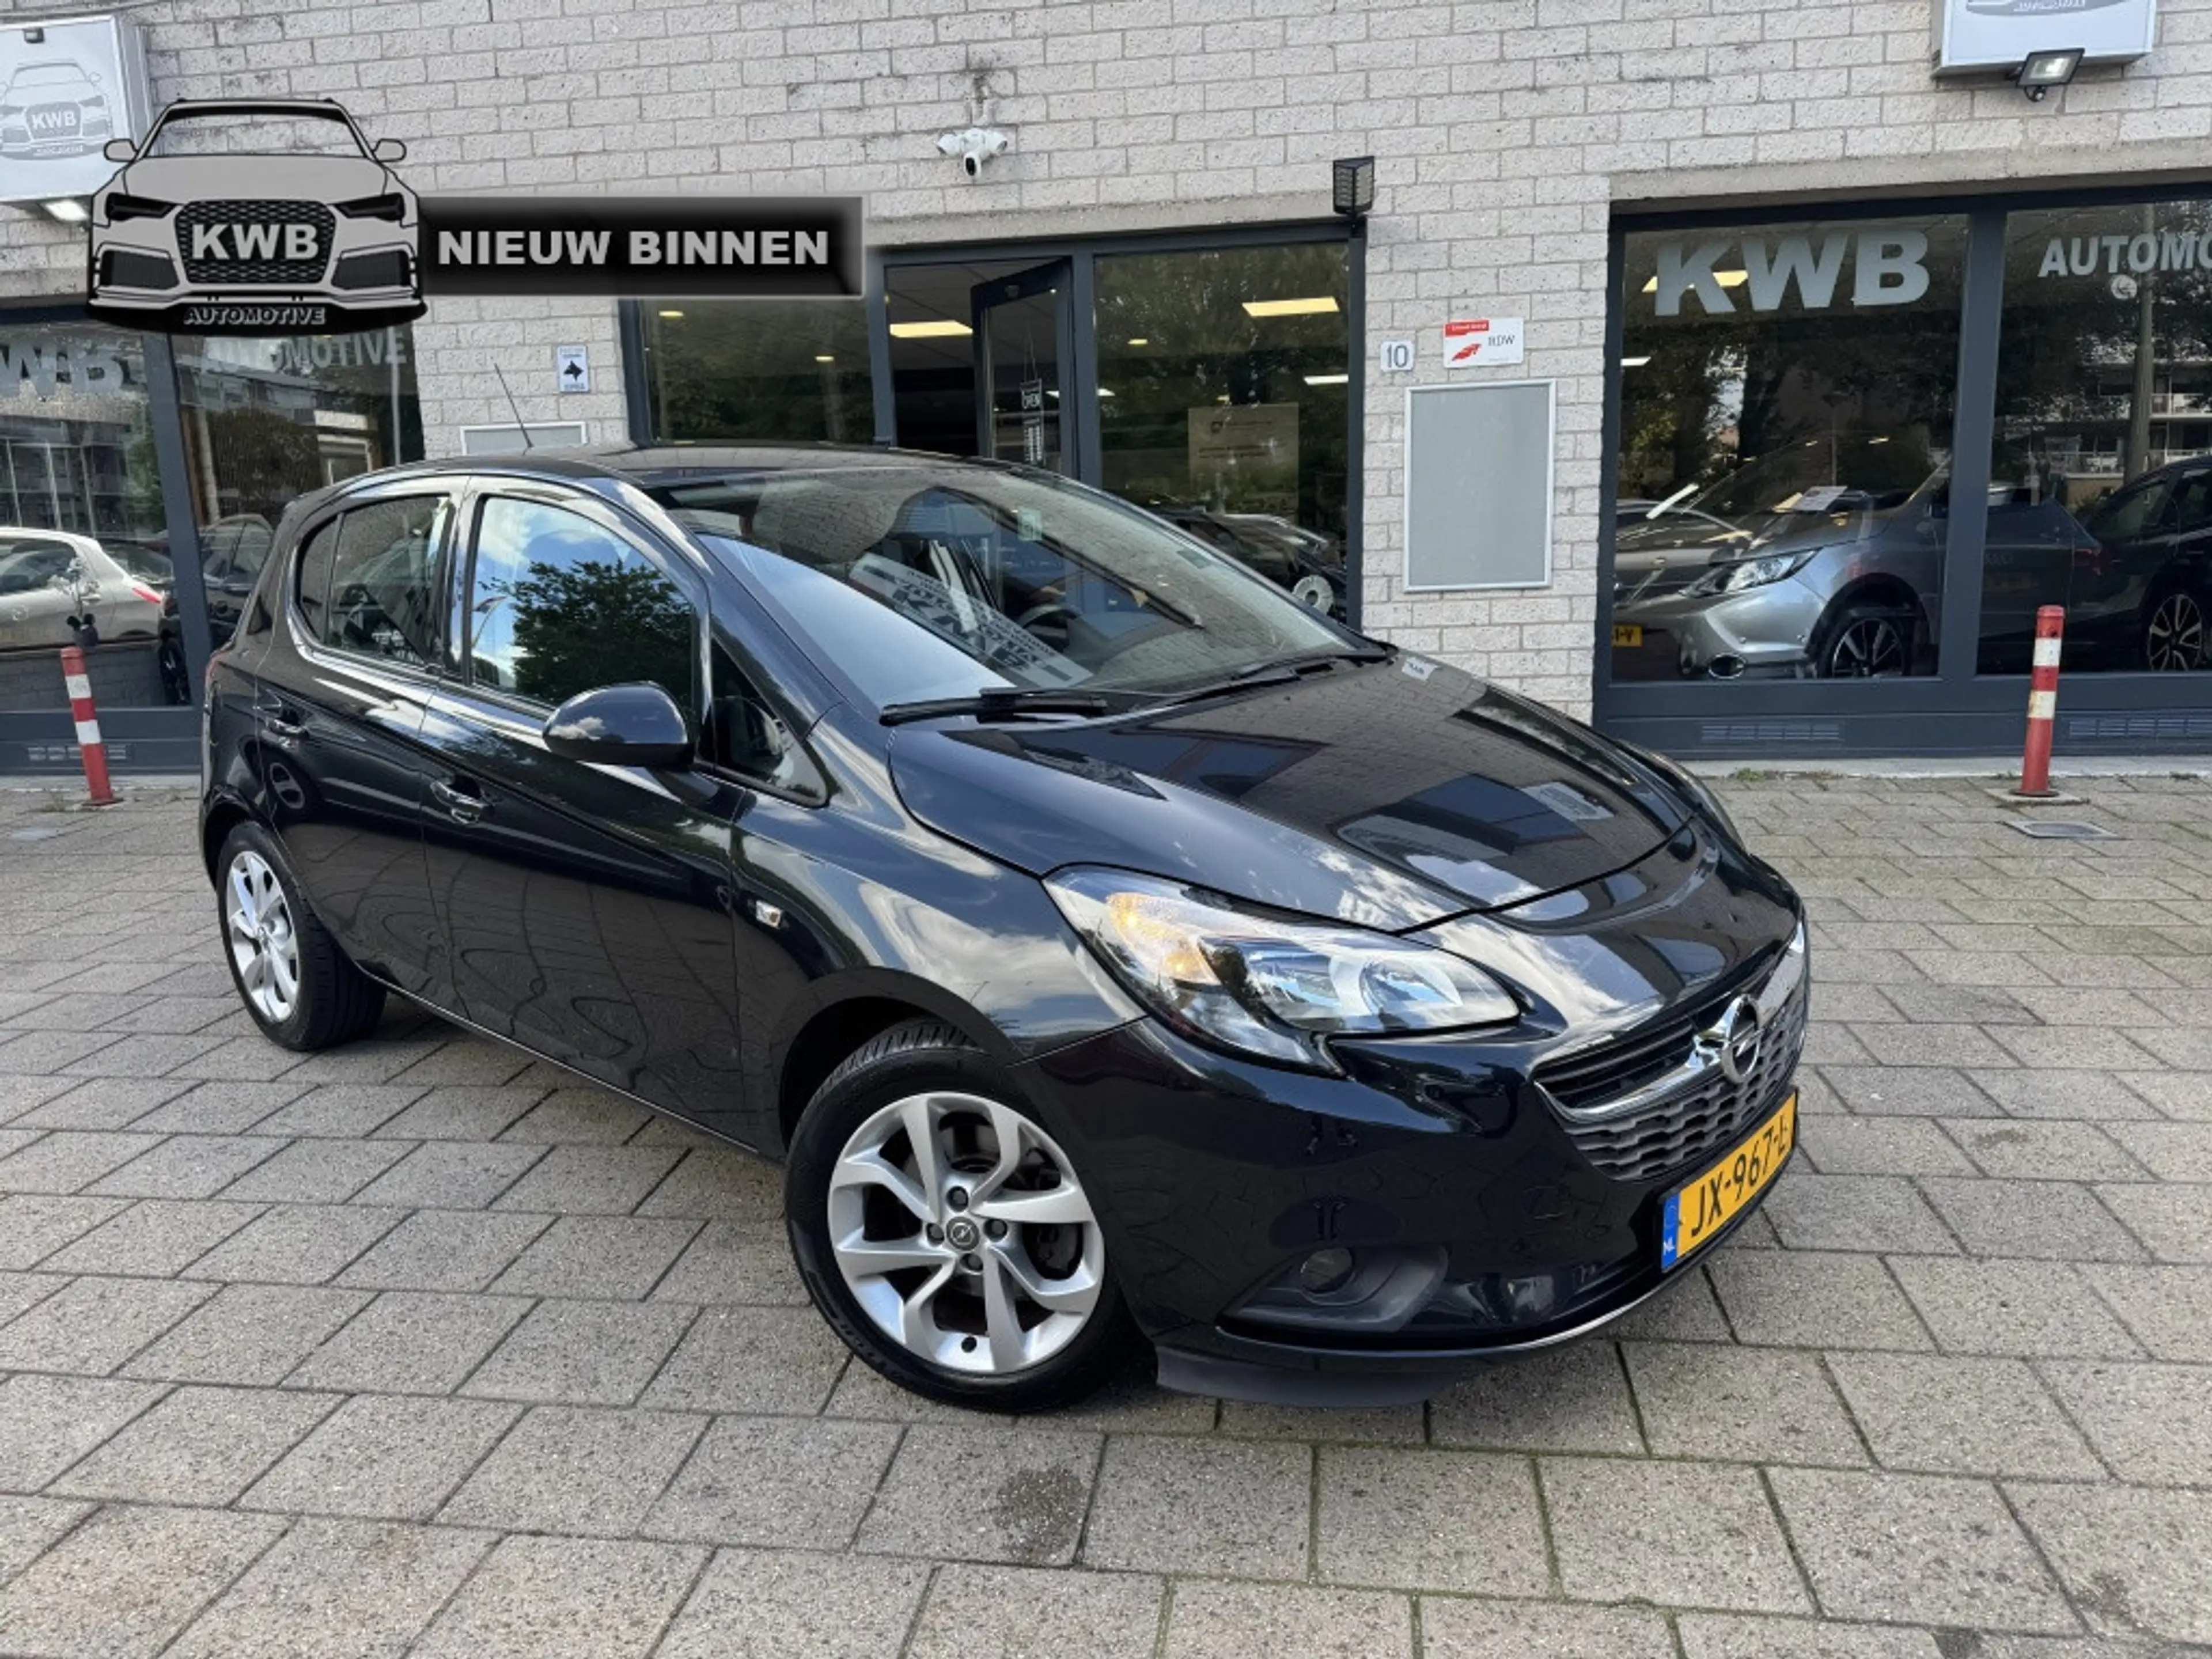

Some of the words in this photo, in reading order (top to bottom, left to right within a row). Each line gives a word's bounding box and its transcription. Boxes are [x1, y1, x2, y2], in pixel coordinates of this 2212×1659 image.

[32, 111, 77, 130] KWB
[1654, 230, 1930, 316] KWB
[1387, 344, 1409, 368] 10
[1691, 1115, 1788, 1237] JX-967-L
